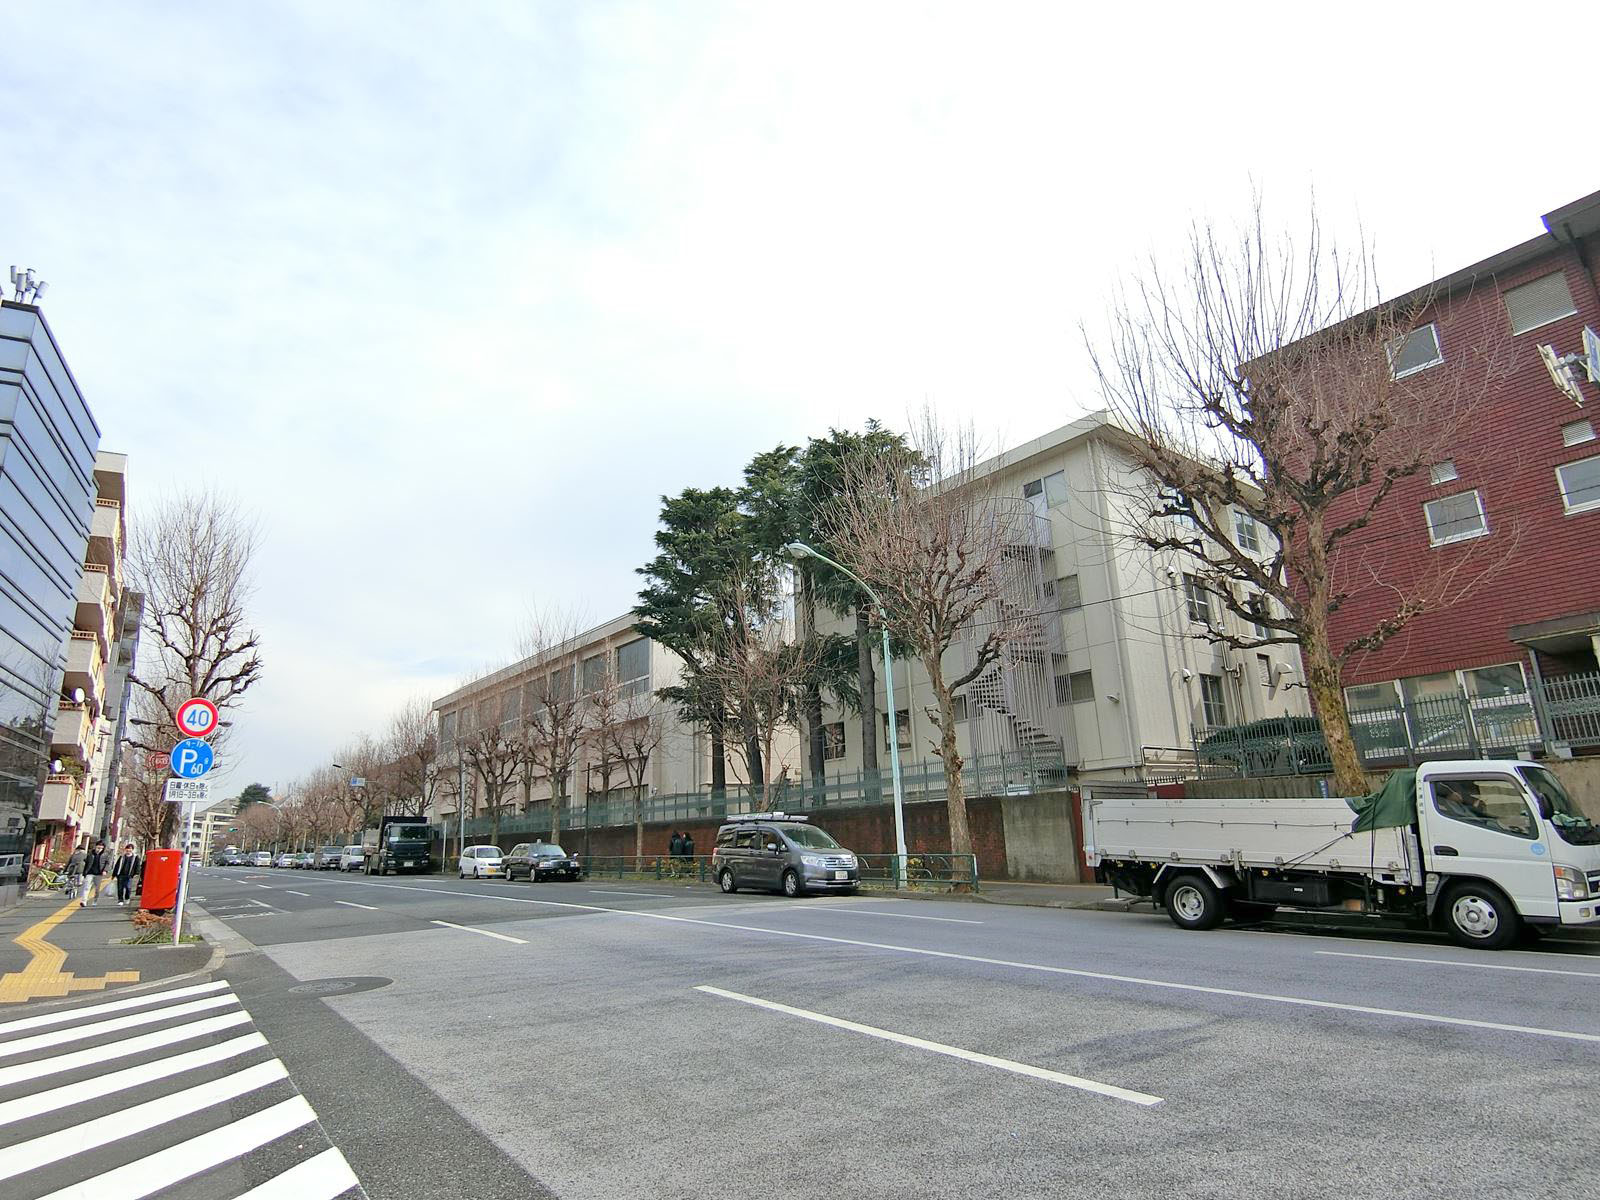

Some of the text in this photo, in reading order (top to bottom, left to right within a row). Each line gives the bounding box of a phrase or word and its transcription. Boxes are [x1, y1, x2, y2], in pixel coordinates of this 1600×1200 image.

[186, 709, 209, 726] 40
[180, 748, 198, 774] P
[191, 763, 203, 774] 60
